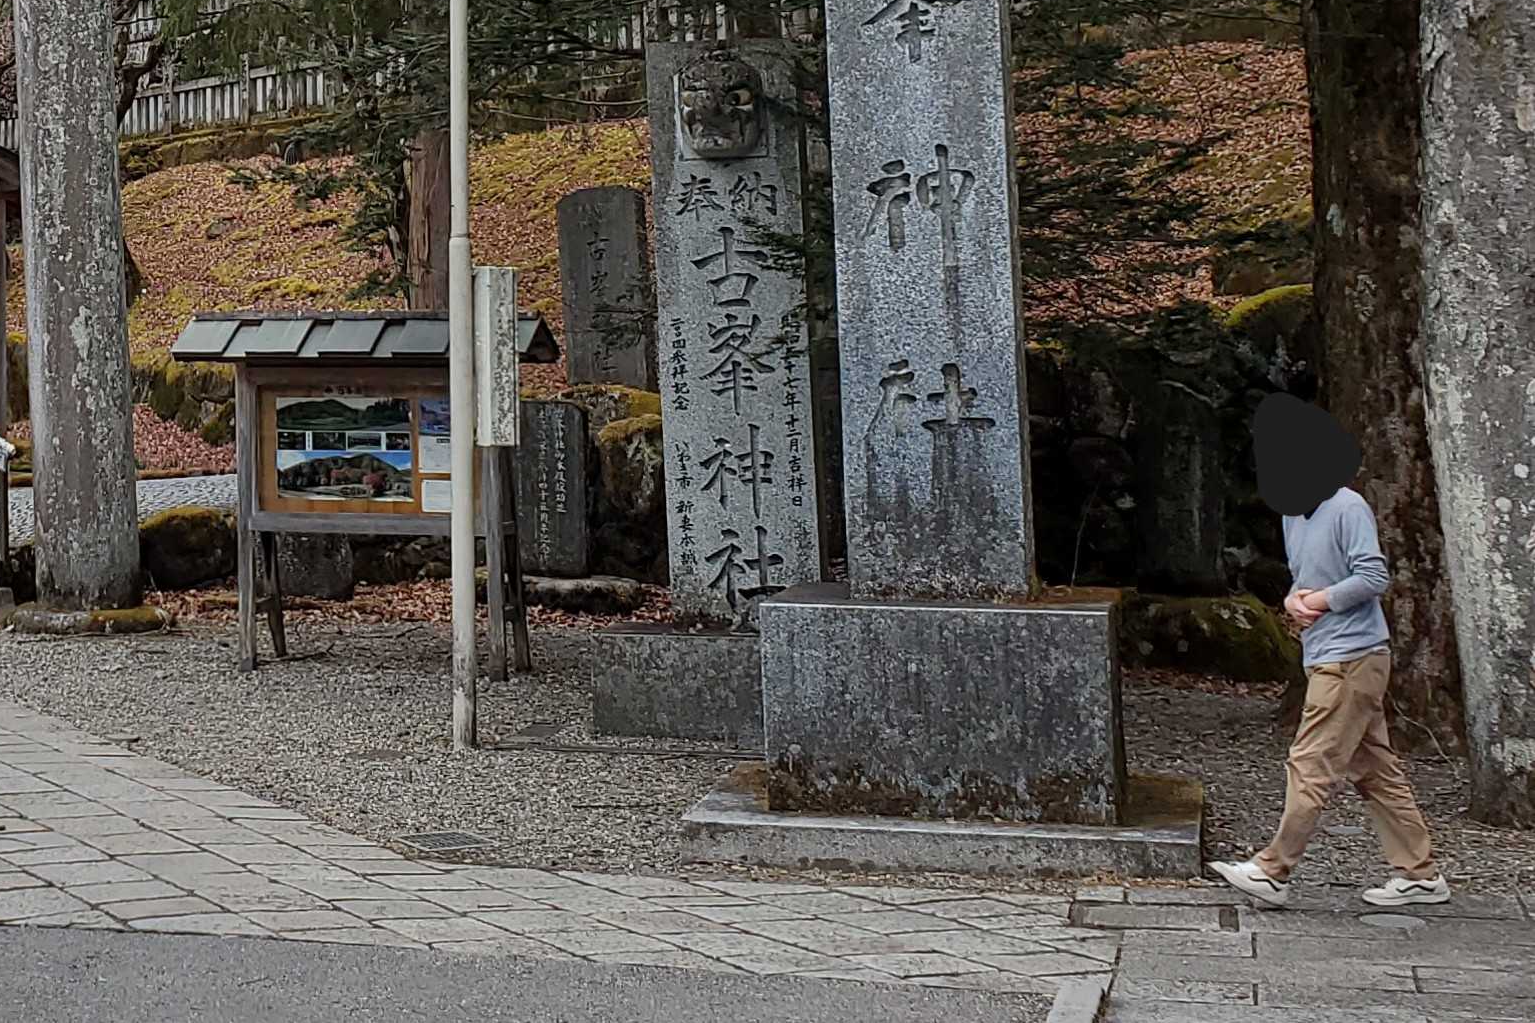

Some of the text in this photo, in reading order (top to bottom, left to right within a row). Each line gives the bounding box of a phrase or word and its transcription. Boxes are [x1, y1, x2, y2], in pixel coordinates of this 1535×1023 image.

[675, 171, 778, 221] 奉納
[690, 226, 787, 610] 古峯神社
